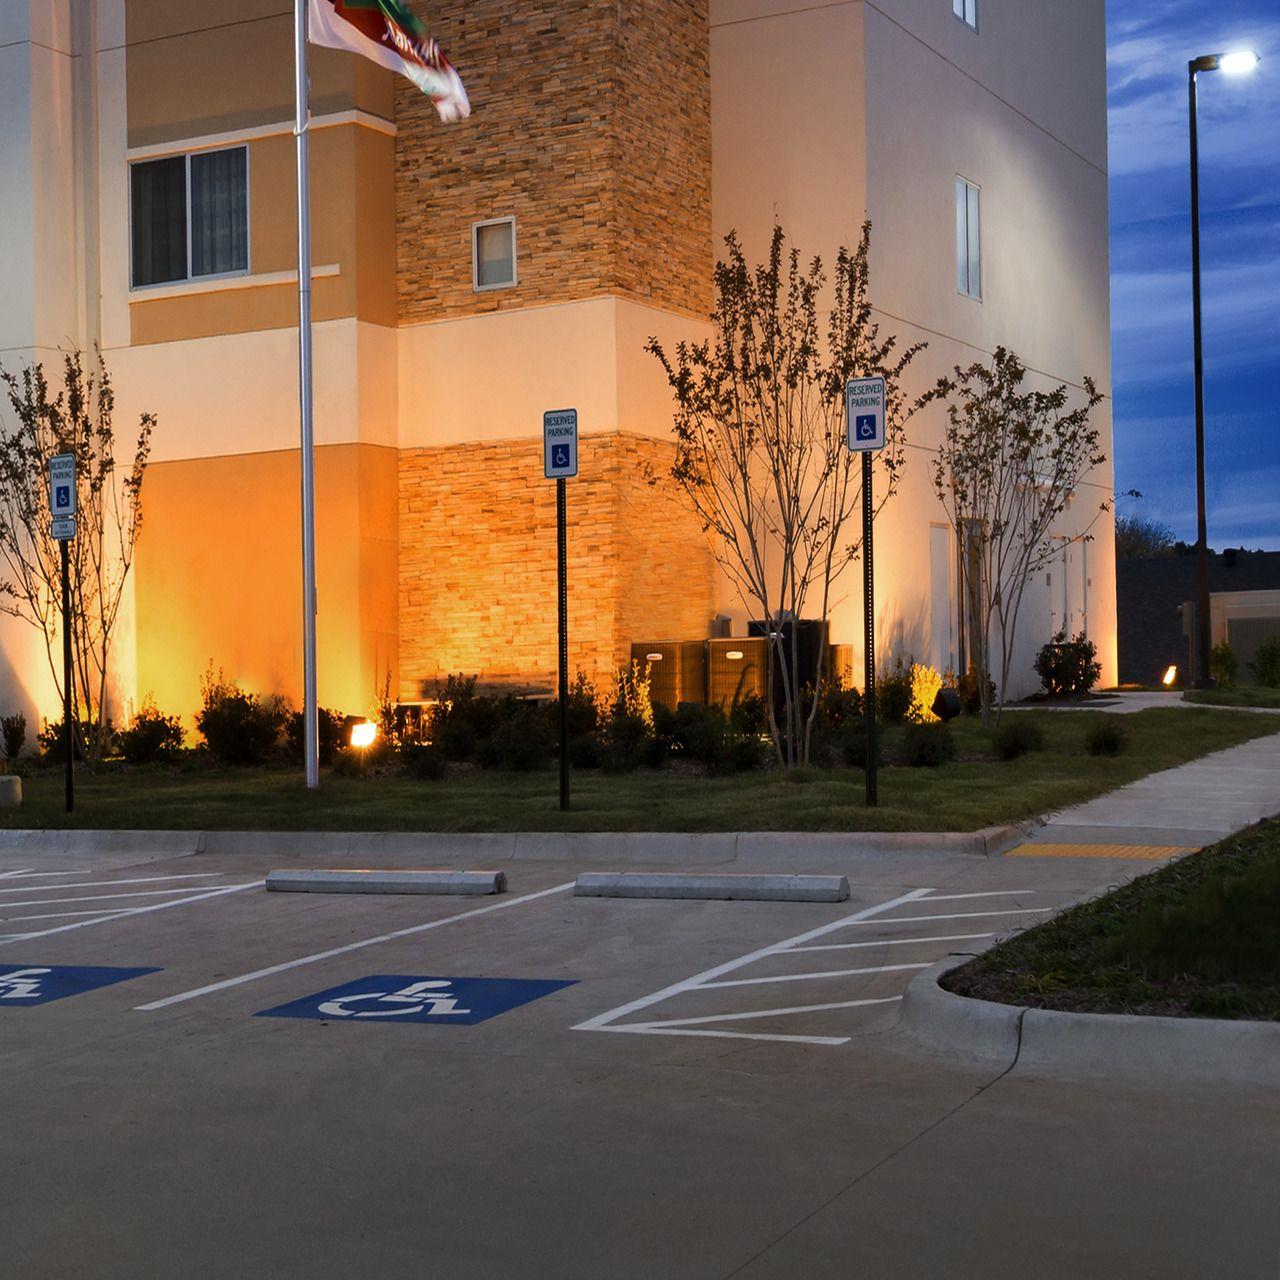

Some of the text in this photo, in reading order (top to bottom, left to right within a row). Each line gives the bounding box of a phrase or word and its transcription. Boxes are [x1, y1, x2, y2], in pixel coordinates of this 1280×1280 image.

[849, 384, 882, 395] RESERVED
[851, 397, 880, 408] PARKING
[545, 415, 575, 426] RESERVED
[548, 427, 573, 437] PARKING
